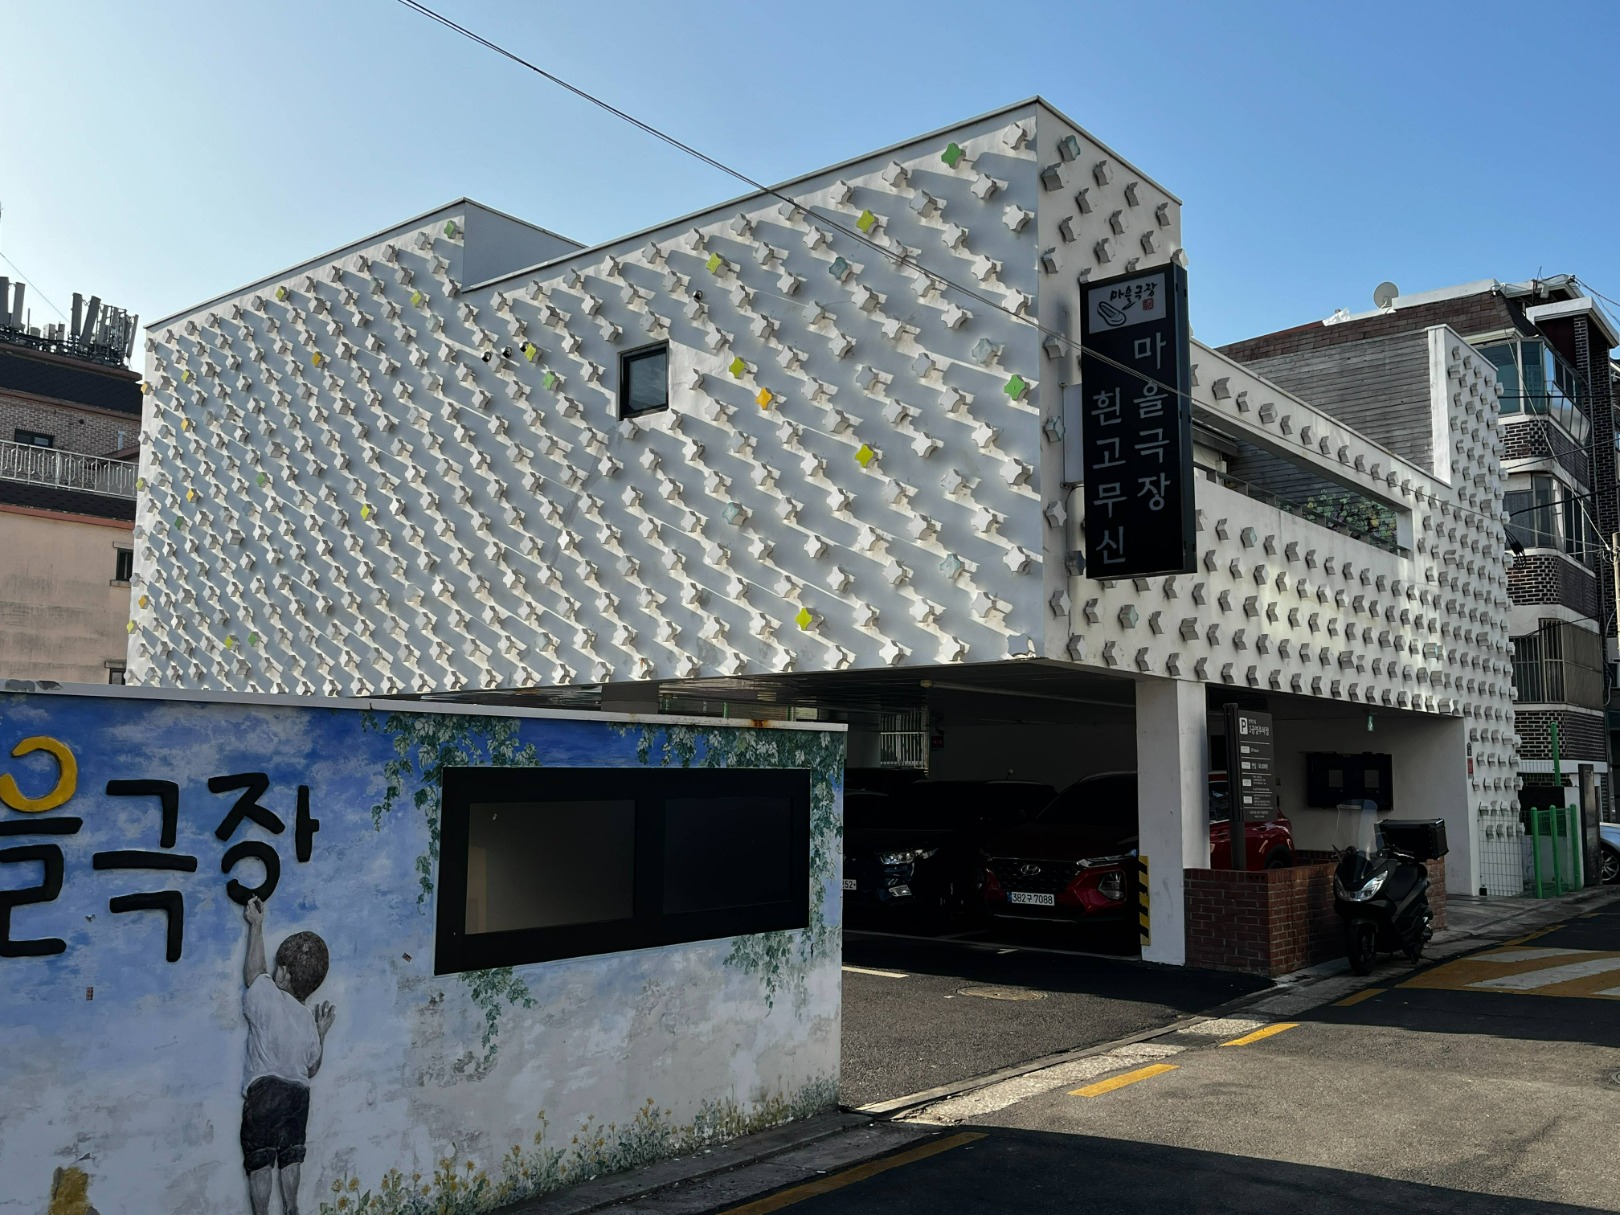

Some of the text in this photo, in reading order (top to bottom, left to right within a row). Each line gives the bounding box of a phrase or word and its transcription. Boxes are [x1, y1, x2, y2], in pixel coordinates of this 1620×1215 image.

[1133, 331, 1171, 511] 마을극장
[1240, 718, 1247, 733] P
[1033, 894, 1053, 905] 7088
